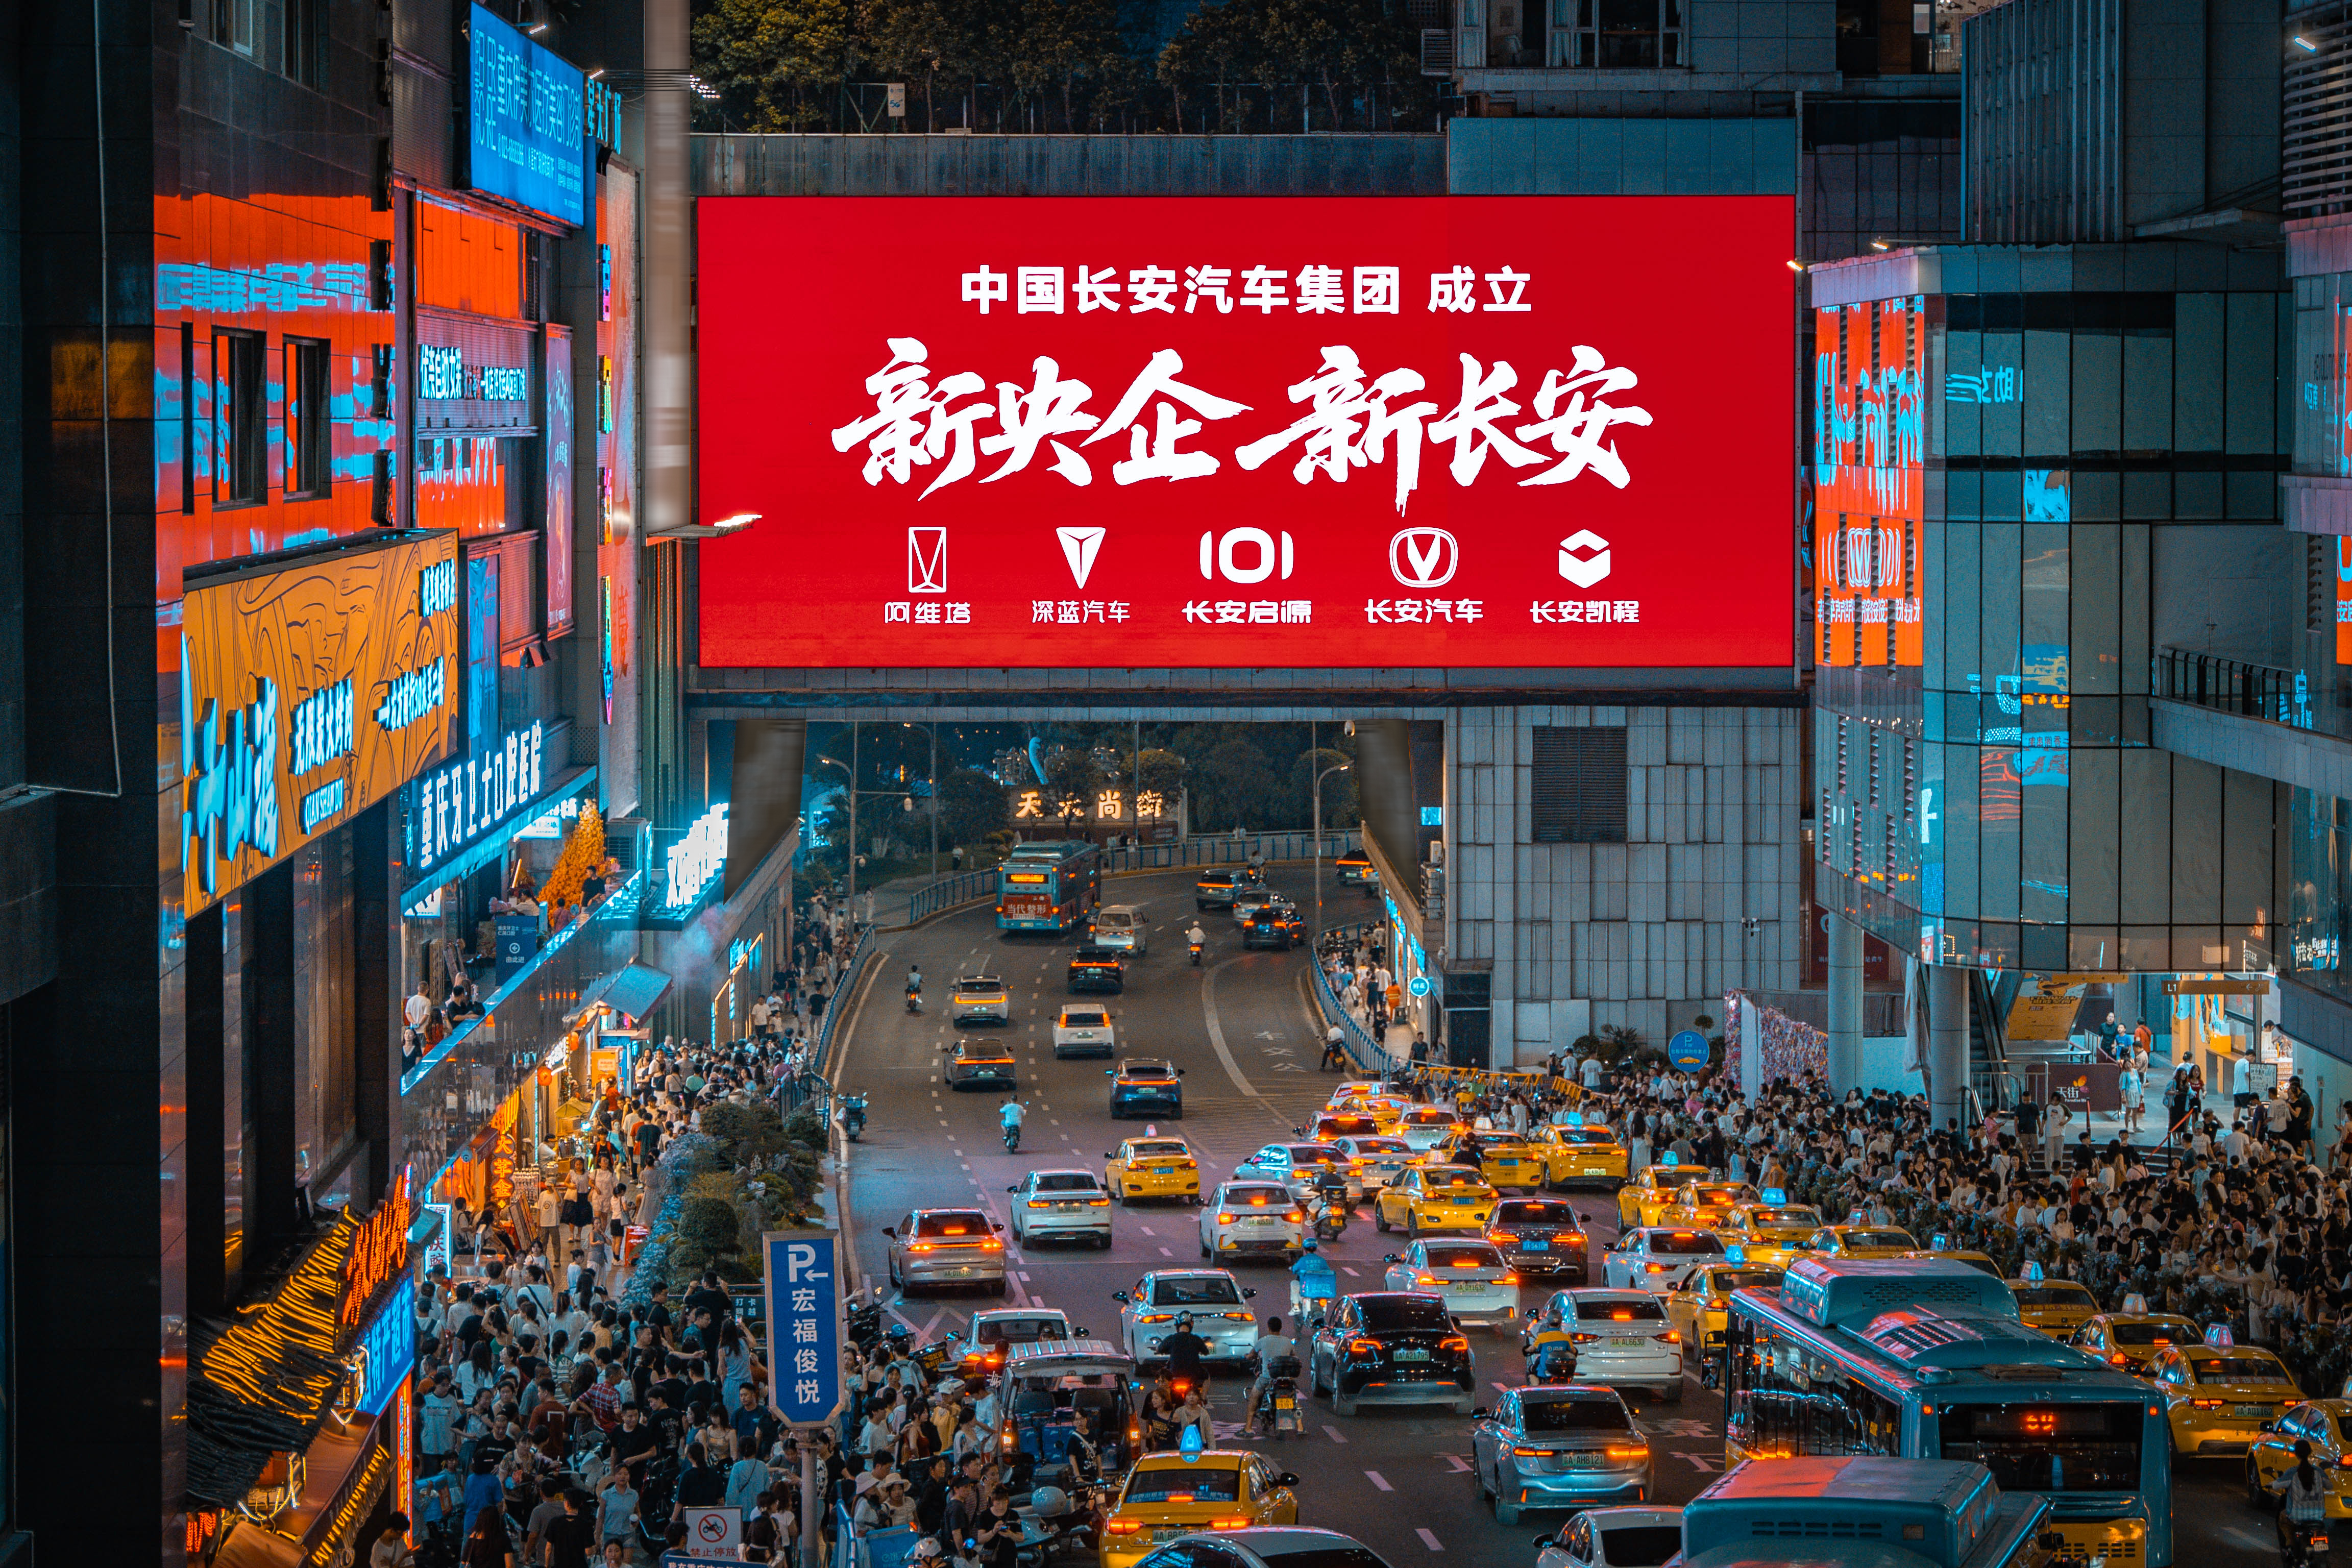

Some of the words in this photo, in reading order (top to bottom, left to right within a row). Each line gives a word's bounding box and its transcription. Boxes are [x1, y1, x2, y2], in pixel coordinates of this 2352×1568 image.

[962, 265, 1399, 314] 中国长安汽车集团
[1428, 265, 1531, 313] 成立
[831, 337, 1253, 501] 新央企
[1234, 345, 1653, 516] 新长安
[885, 601, 971, 623] 阿维塔
[1032, 600, 1130, 623] 深蓝汽车
[1182, 600, 1311, 623] 长安启源
[1364, 599, 1483, 623] 长安汽车
[1530, 600, 1639, 623] 长安凯程
[505, 955, 525, 964] 由此进
[2168, 983, 2176, 992] L1
[788, 1243, 817, 1283] P
[792, 1287, 820, 1405] 宏福俊悦
[1575, 1454, 1604, 1465] AH8121
[690, 1547, 737, 1557] 禁止停放
